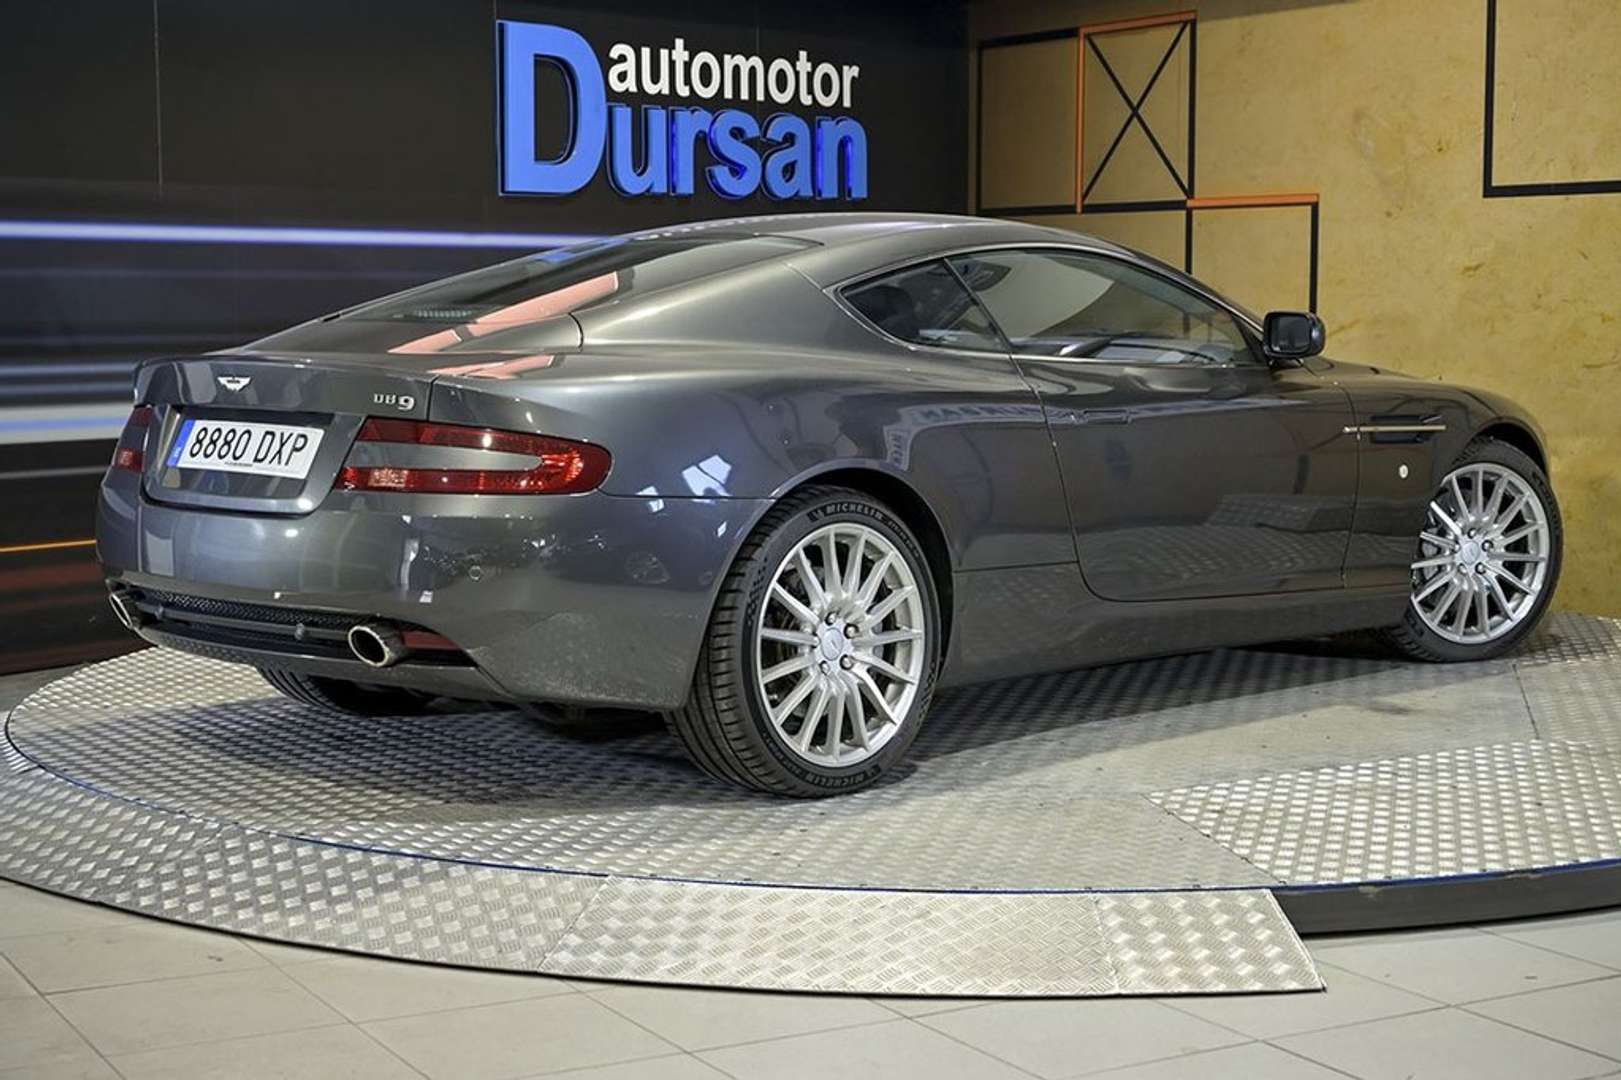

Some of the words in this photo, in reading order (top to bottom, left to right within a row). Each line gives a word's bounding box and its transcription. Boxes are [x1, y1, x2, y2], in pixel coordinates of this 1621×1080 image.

[608, 38, 860, 108] automotor
[496, 20, 868, 200] Dursan
[189, 427, 252, 461] 8880
[253, 430, 309, 466] DXP
[825, 502, 883, 521] MICHELIN
